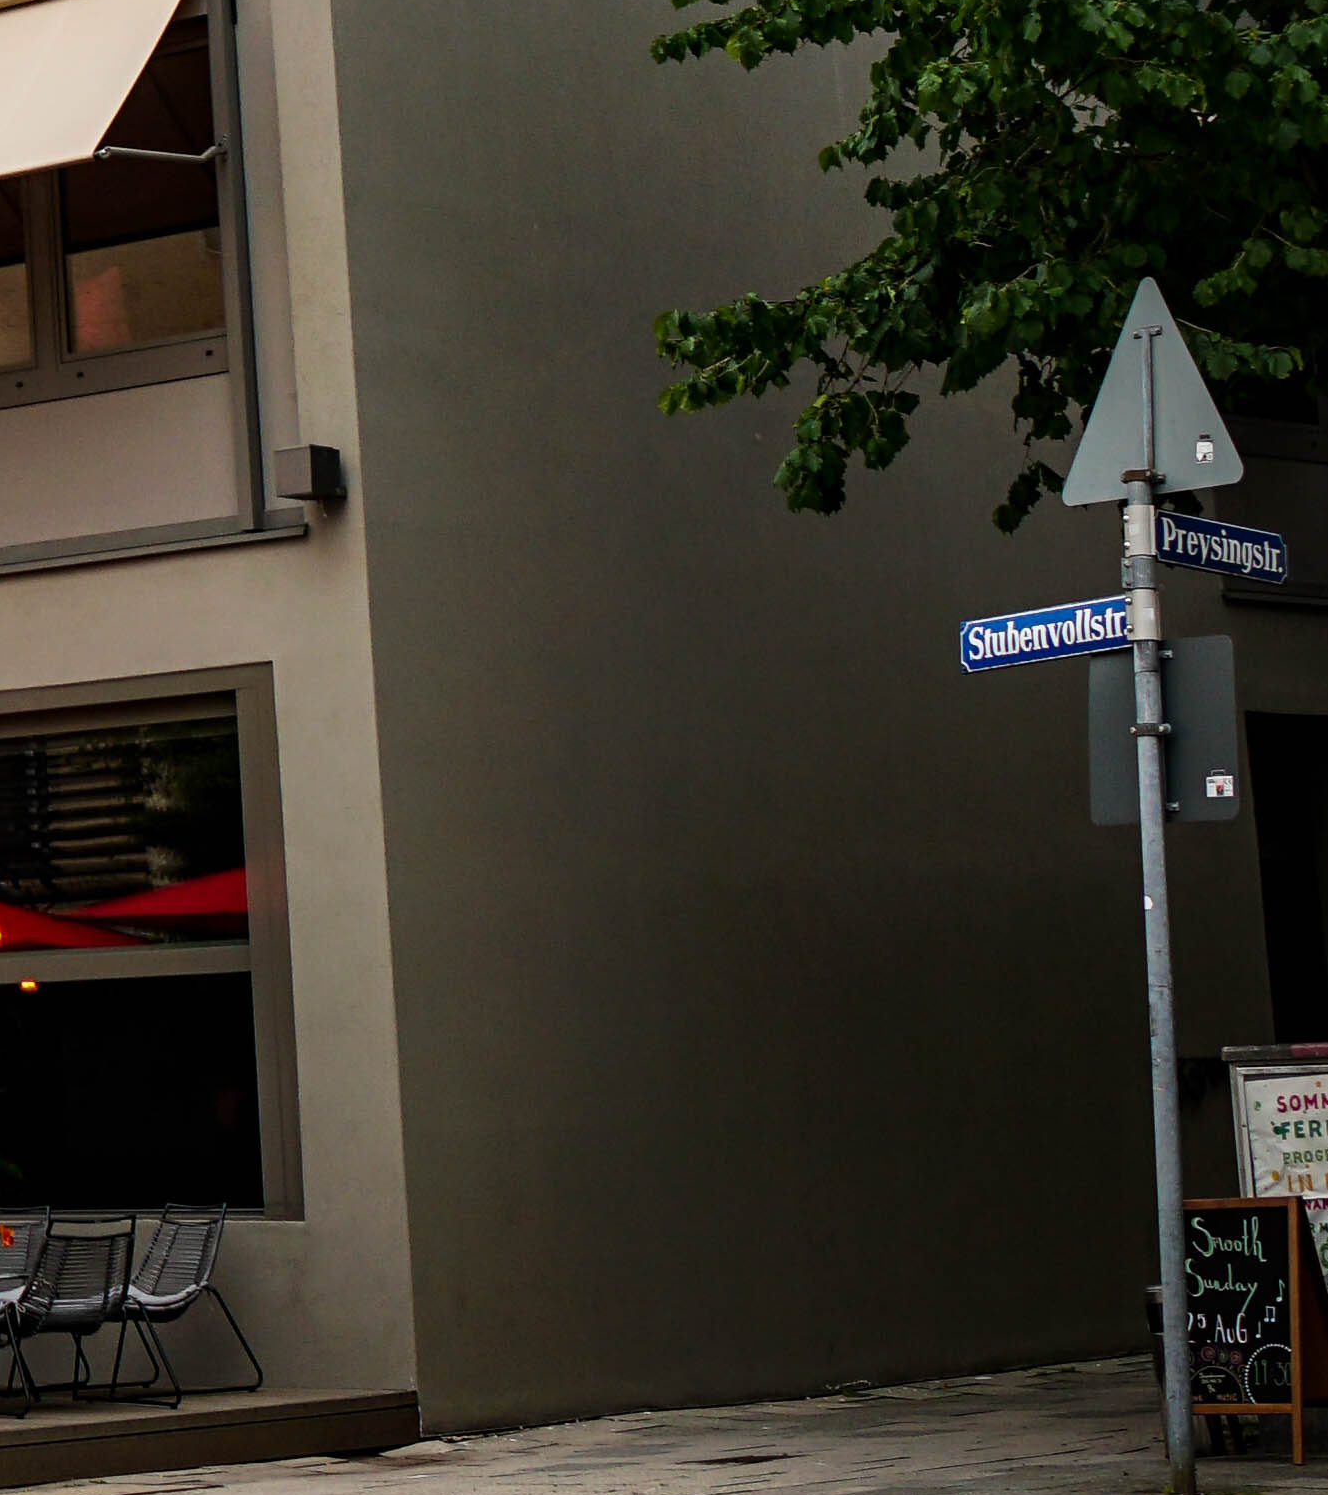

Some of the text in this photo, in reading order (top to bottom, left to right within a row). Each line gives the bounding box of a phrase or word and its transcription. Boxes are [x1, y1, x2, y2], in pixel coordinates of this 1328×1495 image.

[1159, 515, 1284, 574] Preysingstr.
[967, 606, 1128, 661] Stubenvollstr.
[1184, 1257, 1259, 1314] Sunday
